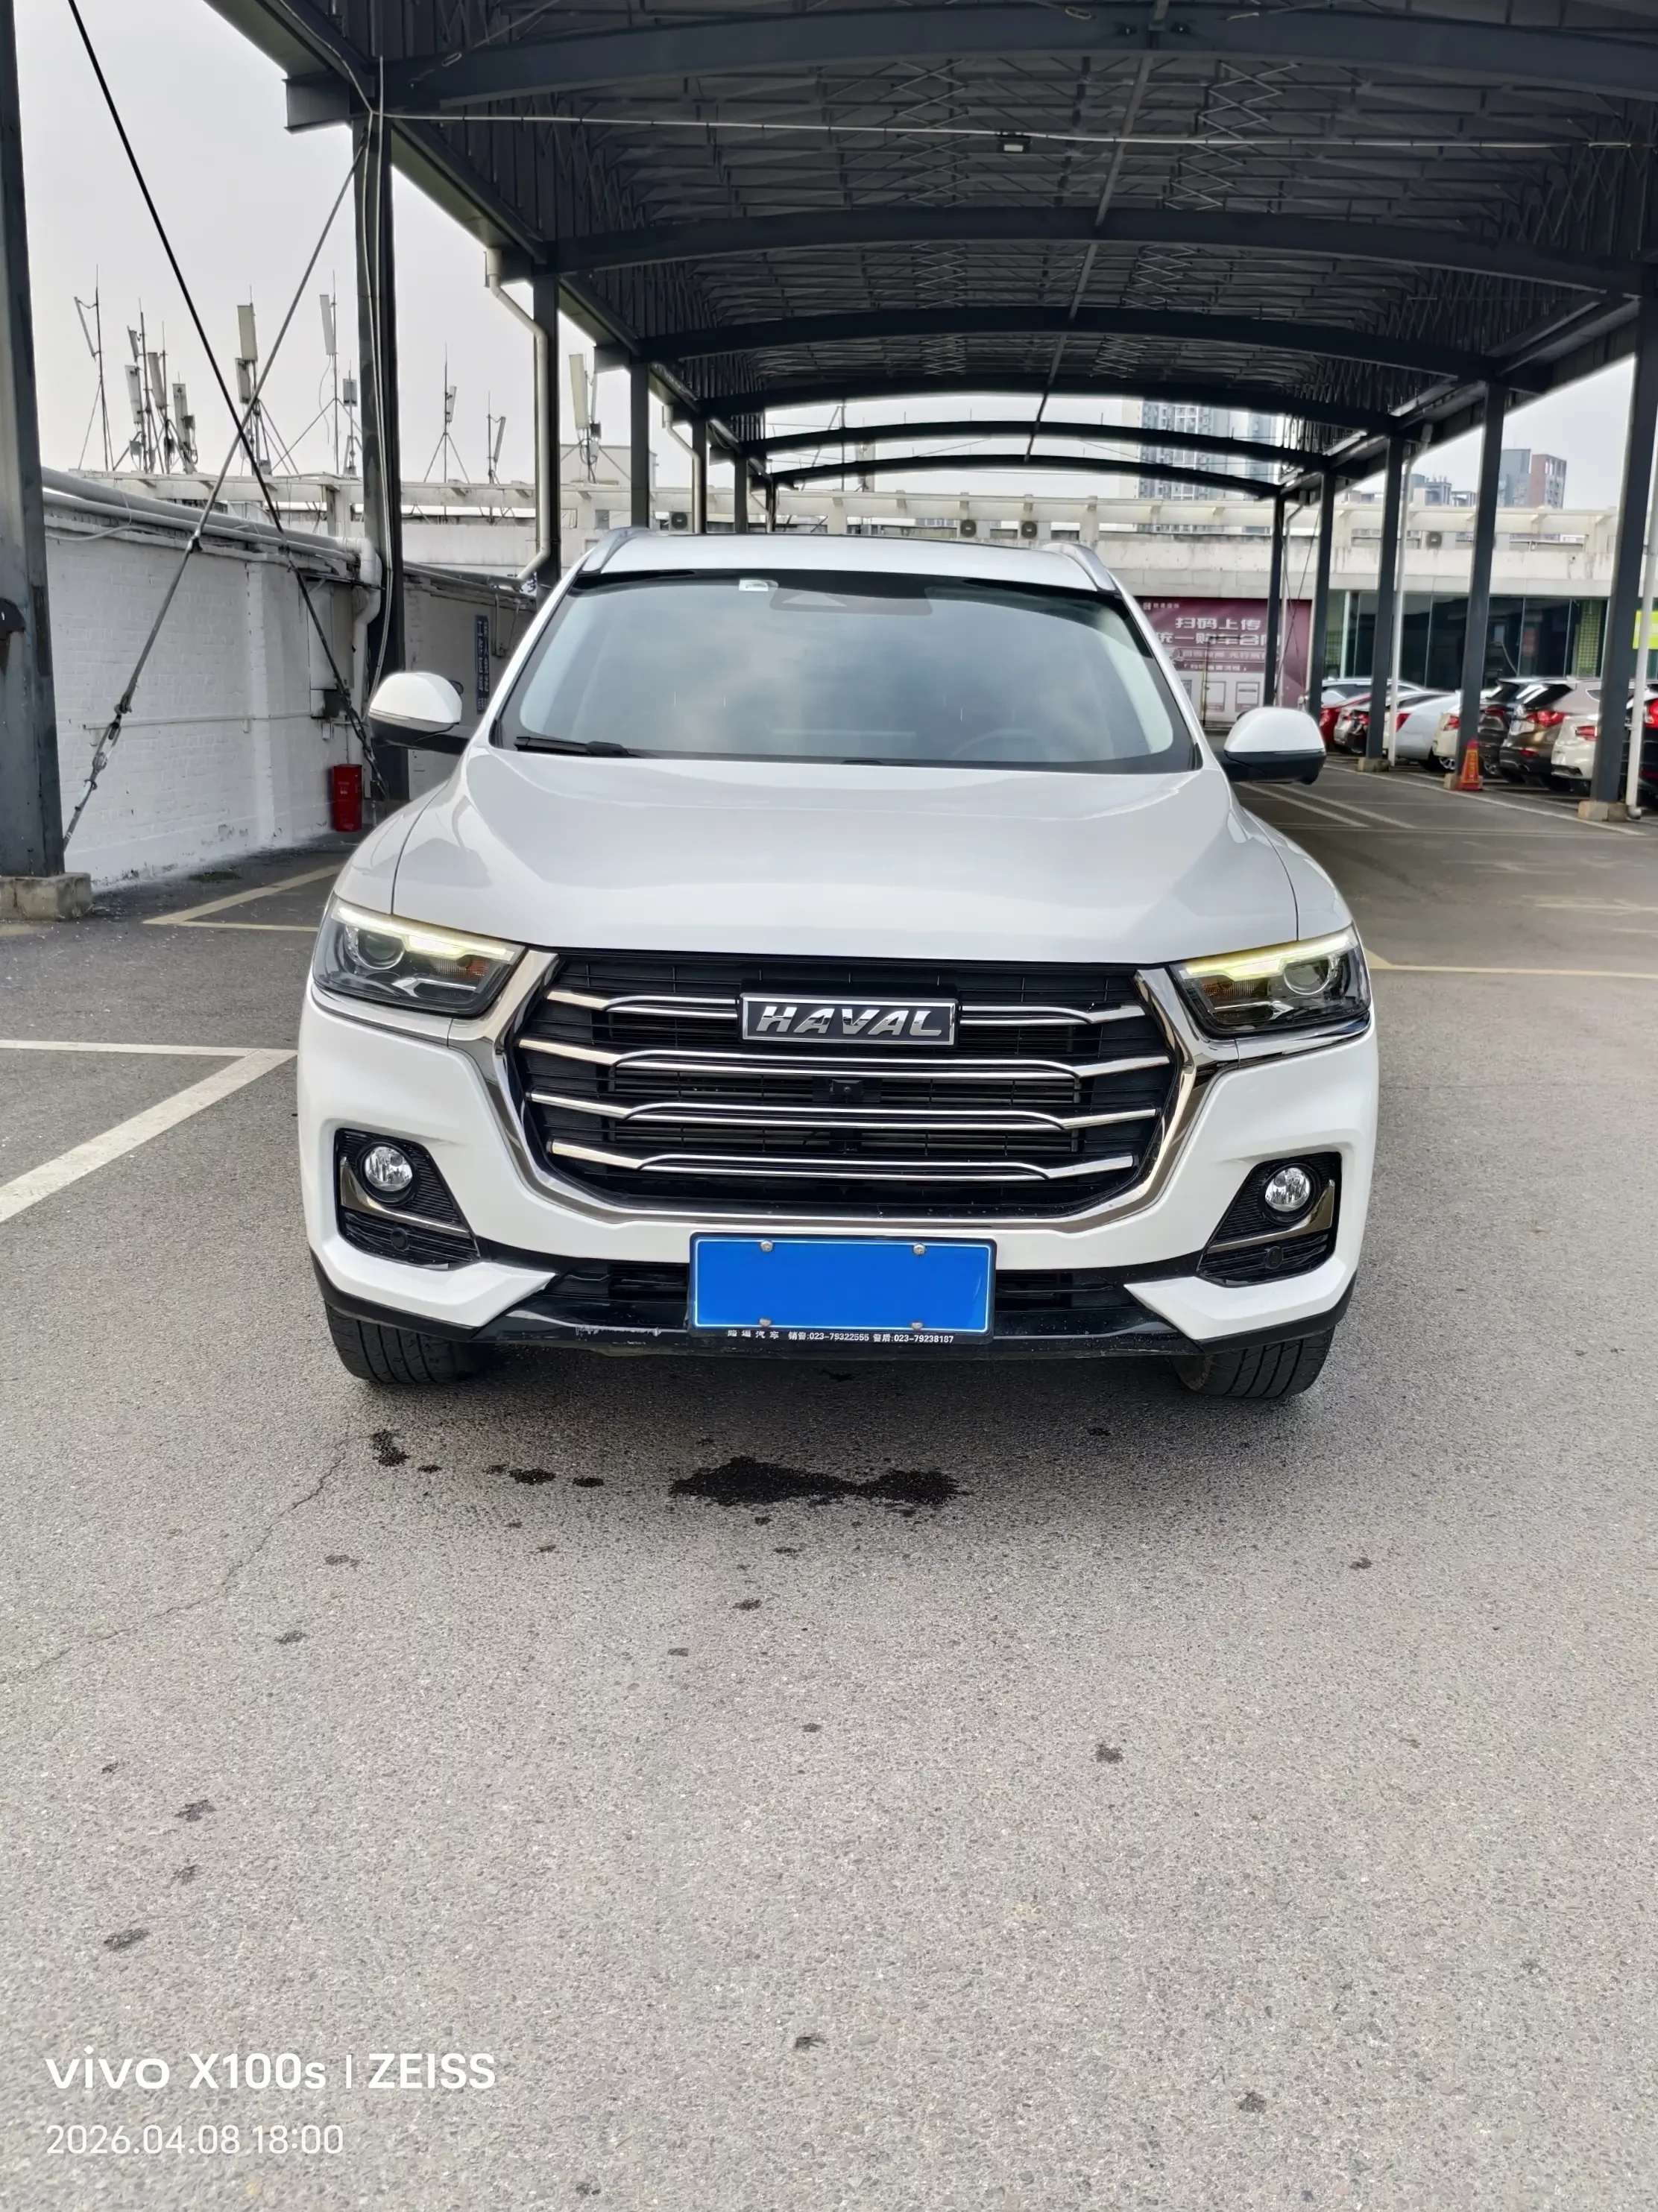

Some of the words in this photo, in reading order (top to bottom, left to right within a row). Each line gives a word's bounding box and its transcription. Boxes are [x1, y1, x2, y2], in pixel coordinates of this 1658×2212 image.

[1175, 618, 1261, 631] 扫码上传
[756, 1005, 942, 1037] HAVAL
